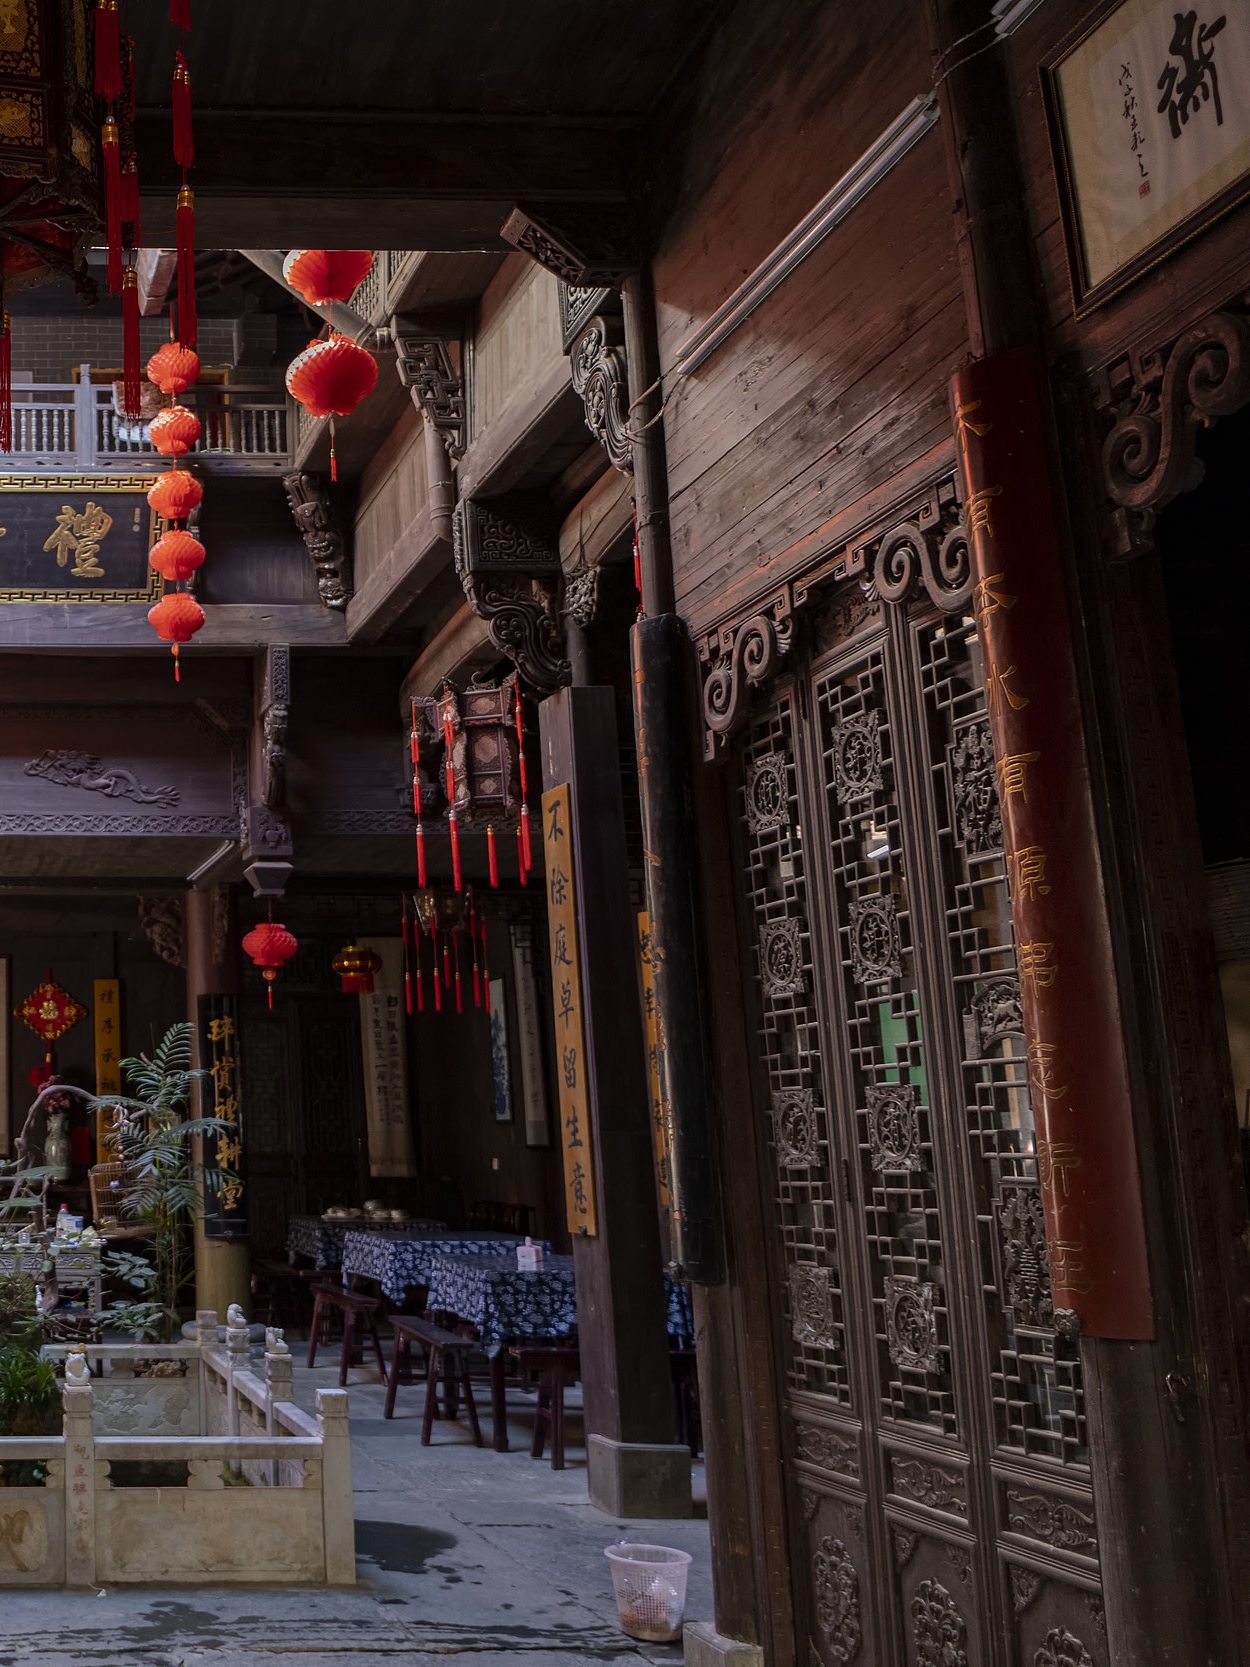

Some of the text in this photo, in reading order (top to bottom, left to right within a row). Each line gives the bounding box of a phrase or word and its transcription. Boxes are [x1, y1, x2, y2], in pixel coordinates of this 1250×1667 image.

[547, 801, 588, 1215] 不除庭草留生意
